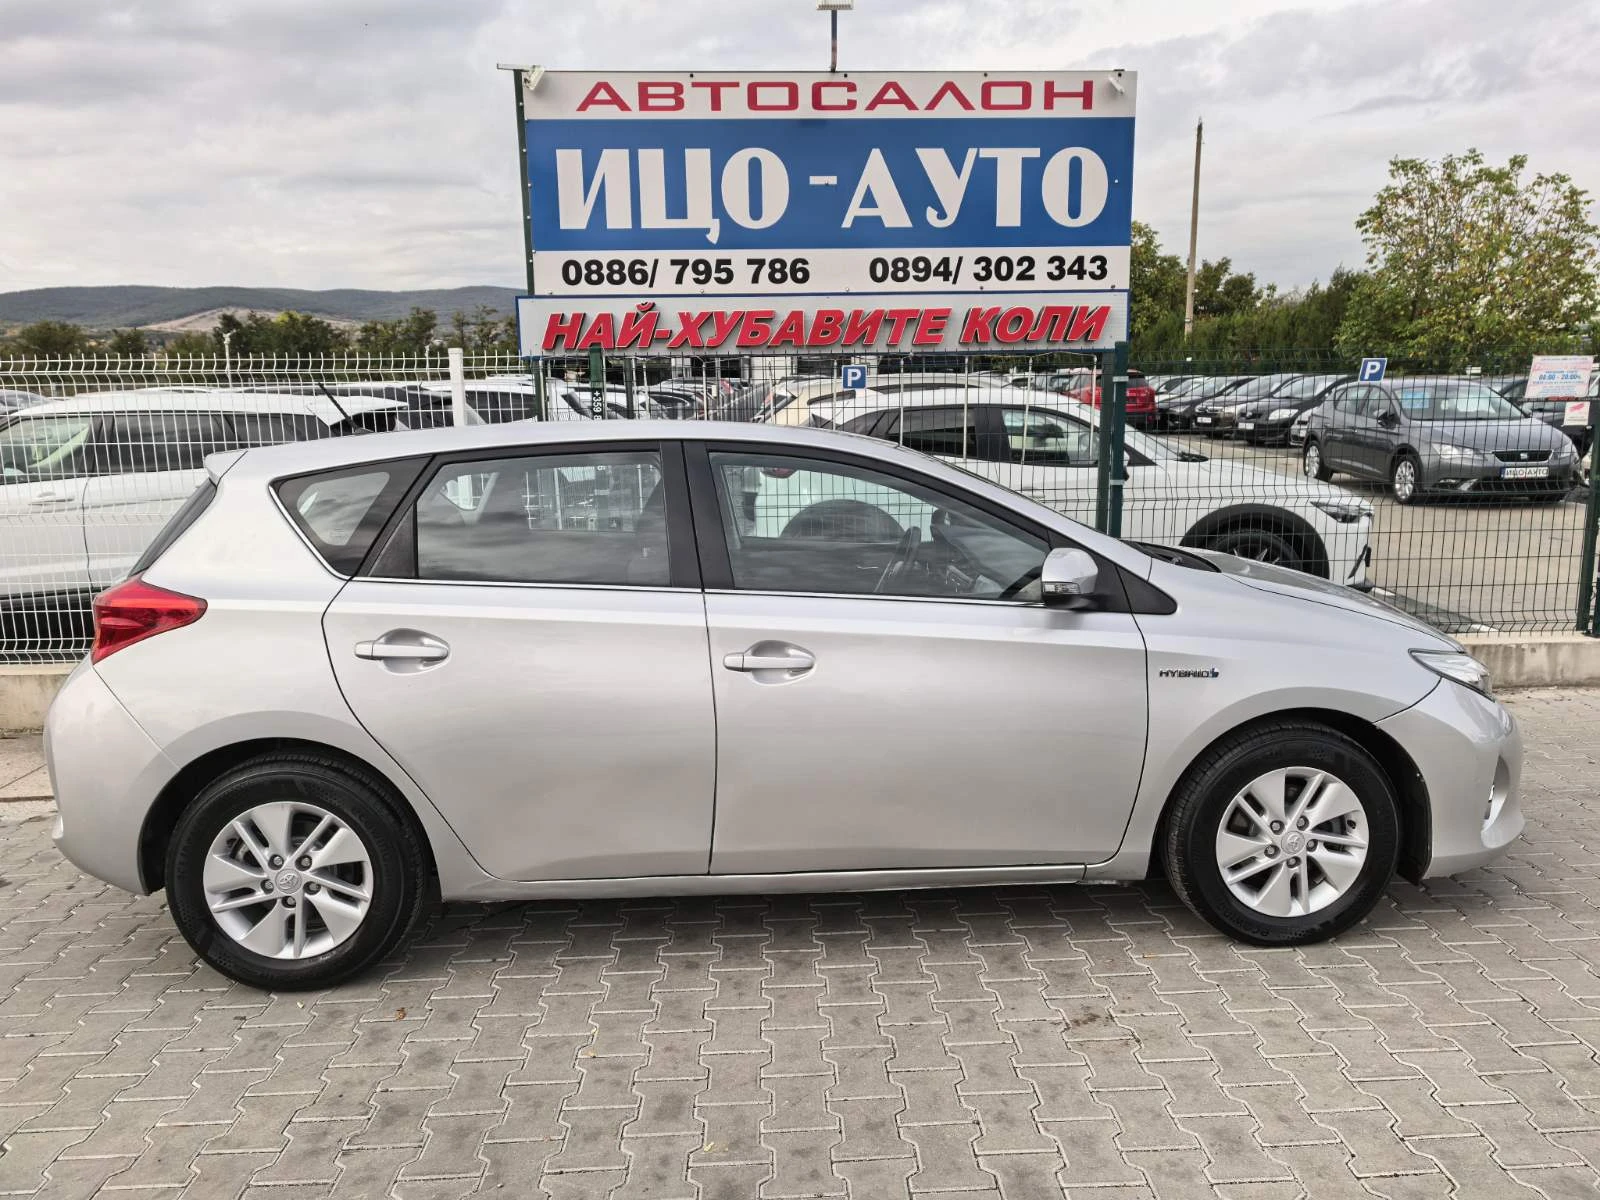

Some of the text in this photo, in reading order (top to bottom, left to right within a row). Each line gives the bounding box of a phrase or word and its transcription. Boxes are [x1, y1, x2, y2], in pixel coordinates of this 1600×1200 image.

[576, 80, 1094, 112] АВТОСАЛОН
[561, 257, 810, 288] 0886/ 795 786
[869, 255, 1108, 285] 0894/ 302 343
[541, 301, 1112, 350] НАЙ-ХУБАВИТЕ КОЛИ
[847, 368, 862, 387] P
[1364, 361, 1381, 380] P
[592, 390, 602, 413] +359
[1159, 668, 1210, 678] HYBRID
